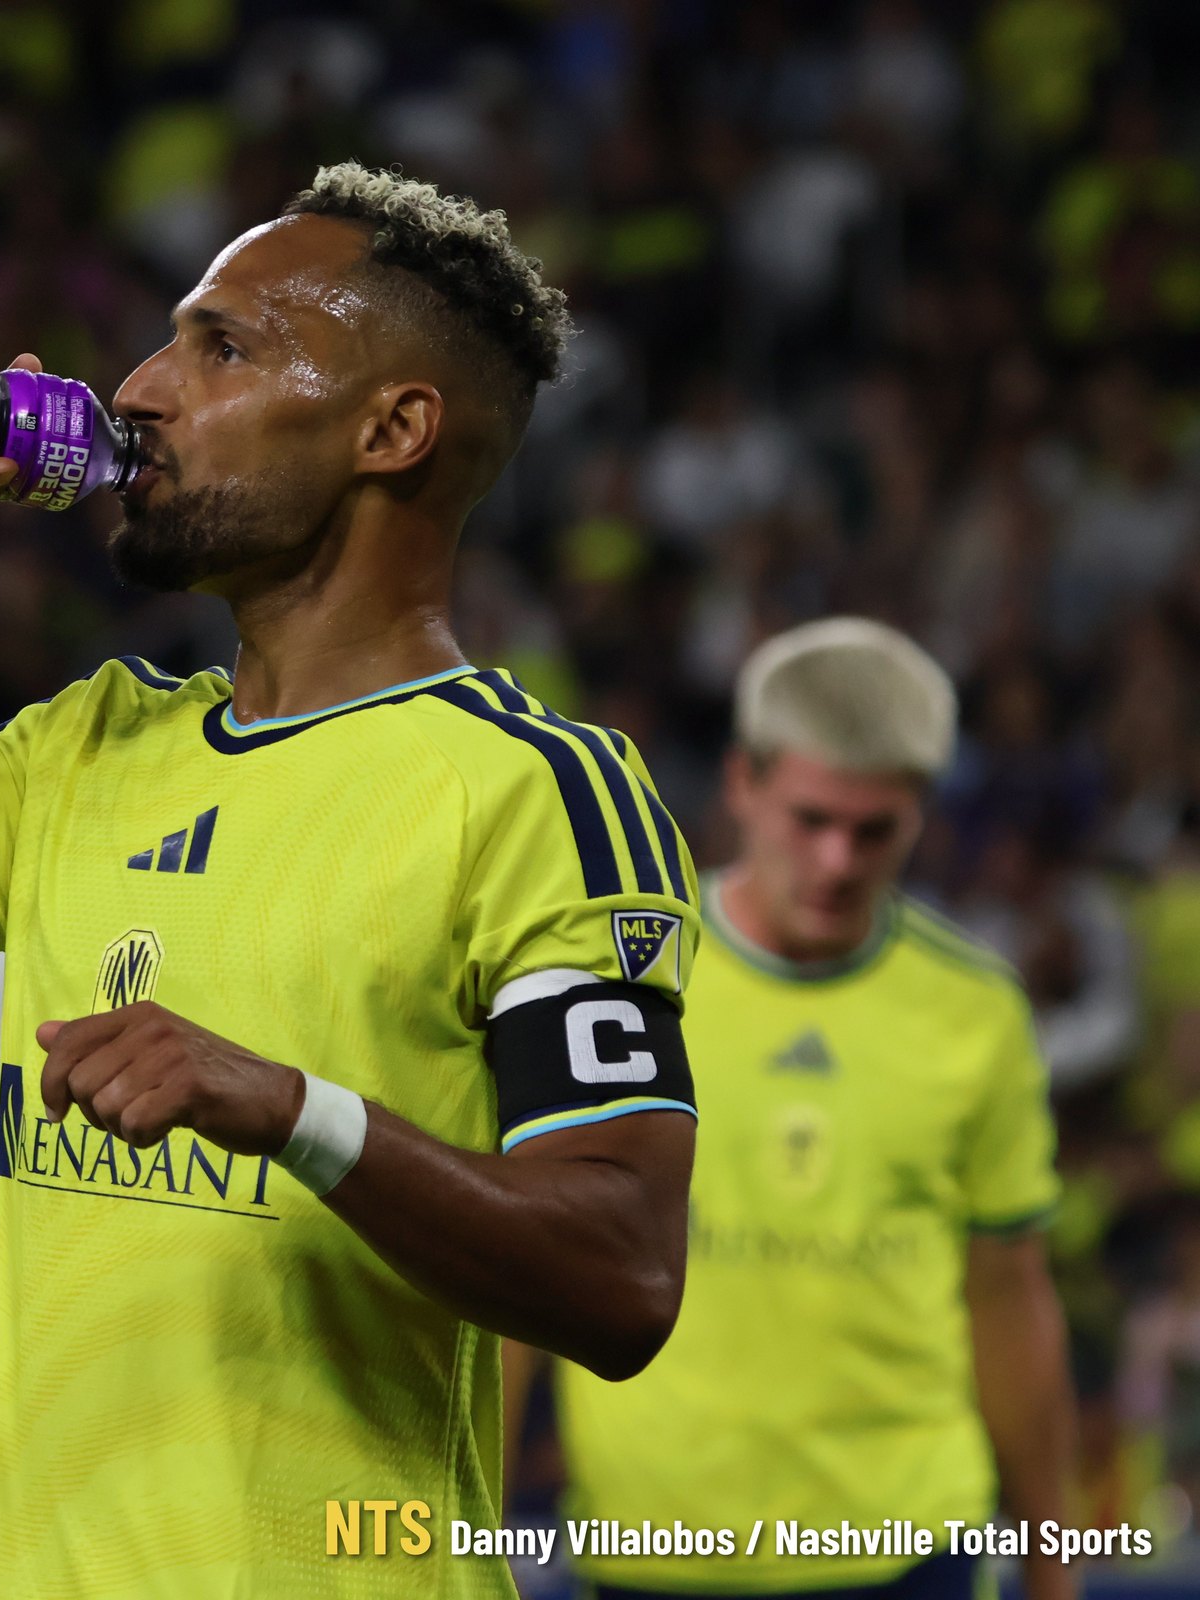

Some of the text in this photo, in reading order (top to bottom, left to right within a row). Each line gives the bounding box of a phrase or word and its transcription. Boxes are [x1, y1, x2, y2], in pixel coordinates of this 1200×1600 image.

[26, 415, 37, 430] 130
[59, 406, 67, 433] LEADING
[75, 413, 84, 437] MORE
[38, 440, 48, 465] GRAPE
[38, 442, 68, 489] ADE
[48, 446, 89, 511] POWER
[621, 919, 662, 940] MLS
[565, 1000, 658, 1084] C
